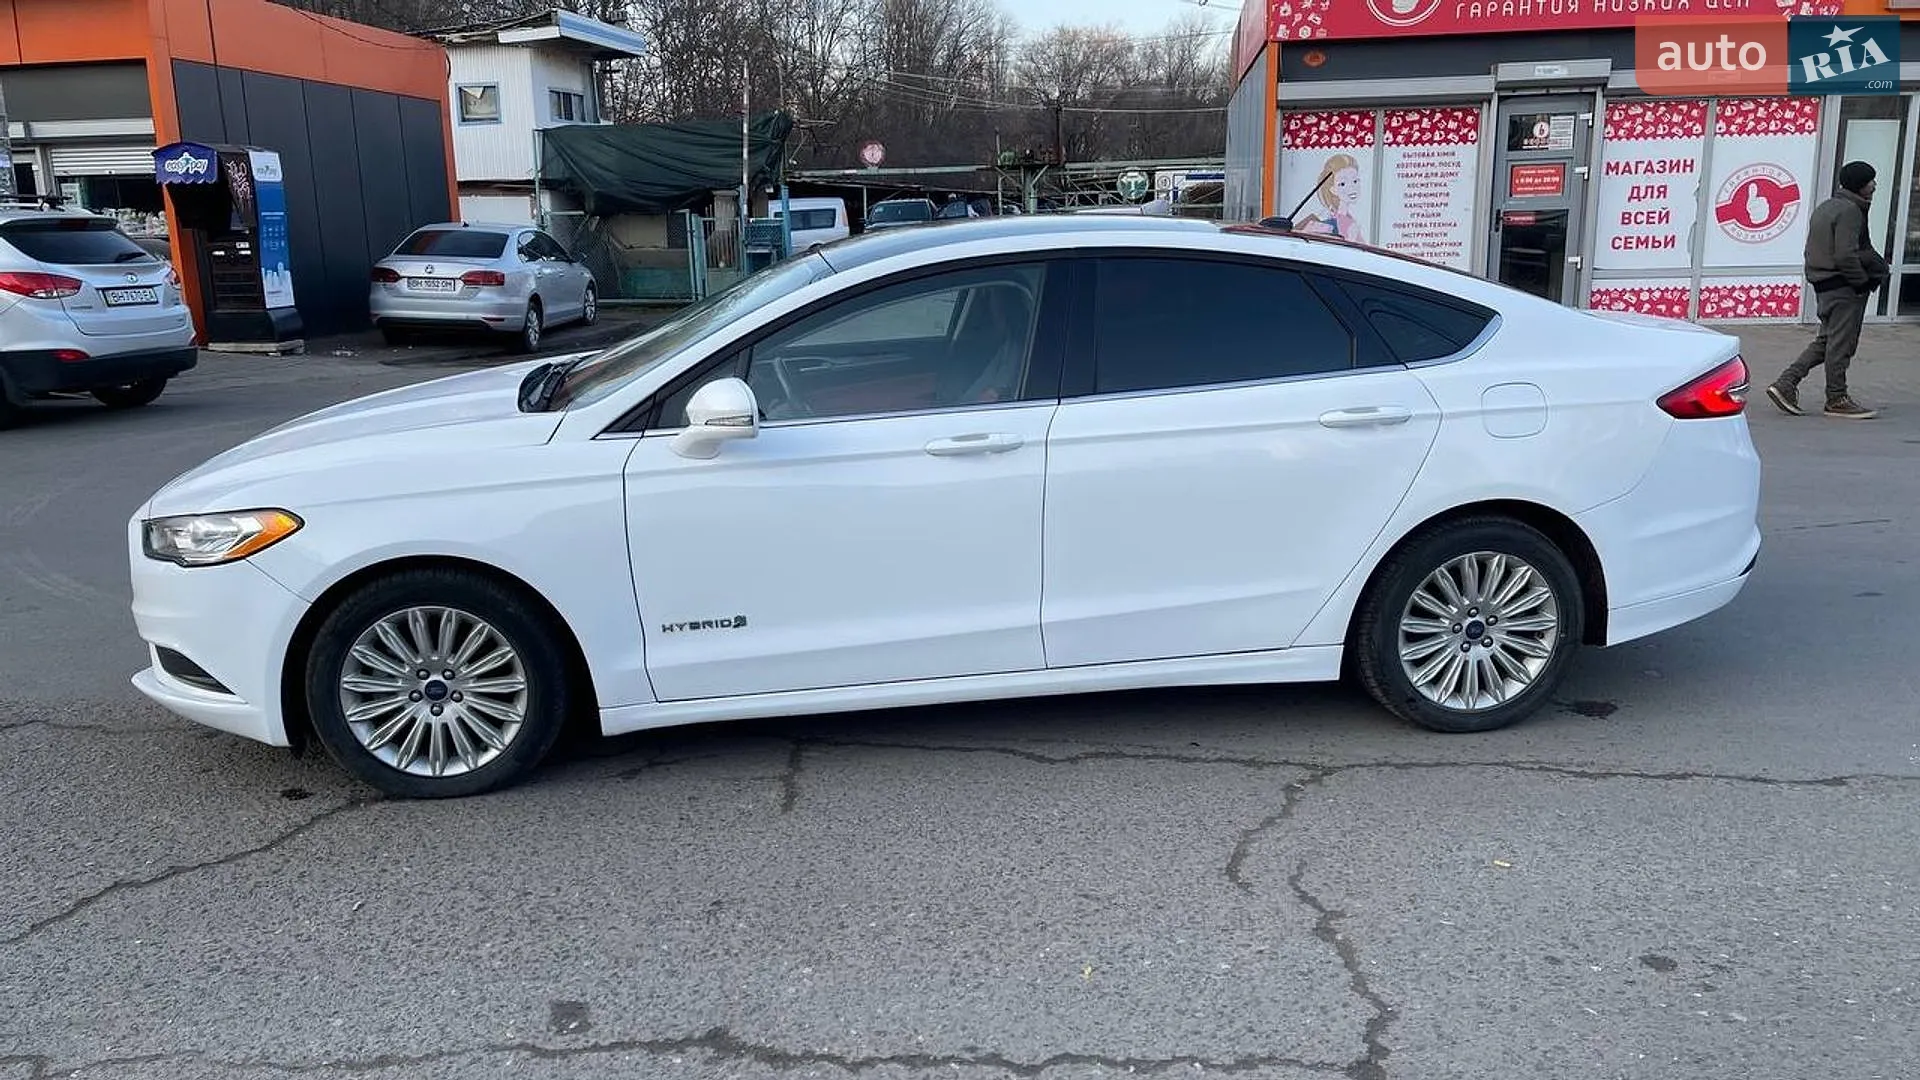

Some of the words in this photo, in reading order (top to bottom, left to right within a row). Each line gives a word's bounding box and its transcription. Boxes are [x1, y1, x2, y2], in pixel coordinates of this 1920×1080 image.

[1456, 0, 1579, 19] ГАРАНТИЯ
[1604, 158, 1695, 176] МАГАЗИН
[1627, 185, 1668, 201] ДЛЯ
[1620, 207, 1670, 225] ВСЕЙ
[1610, 235, 1676, 250] СЕМЬИ
[661, 619, 732, 633] HYBRID
